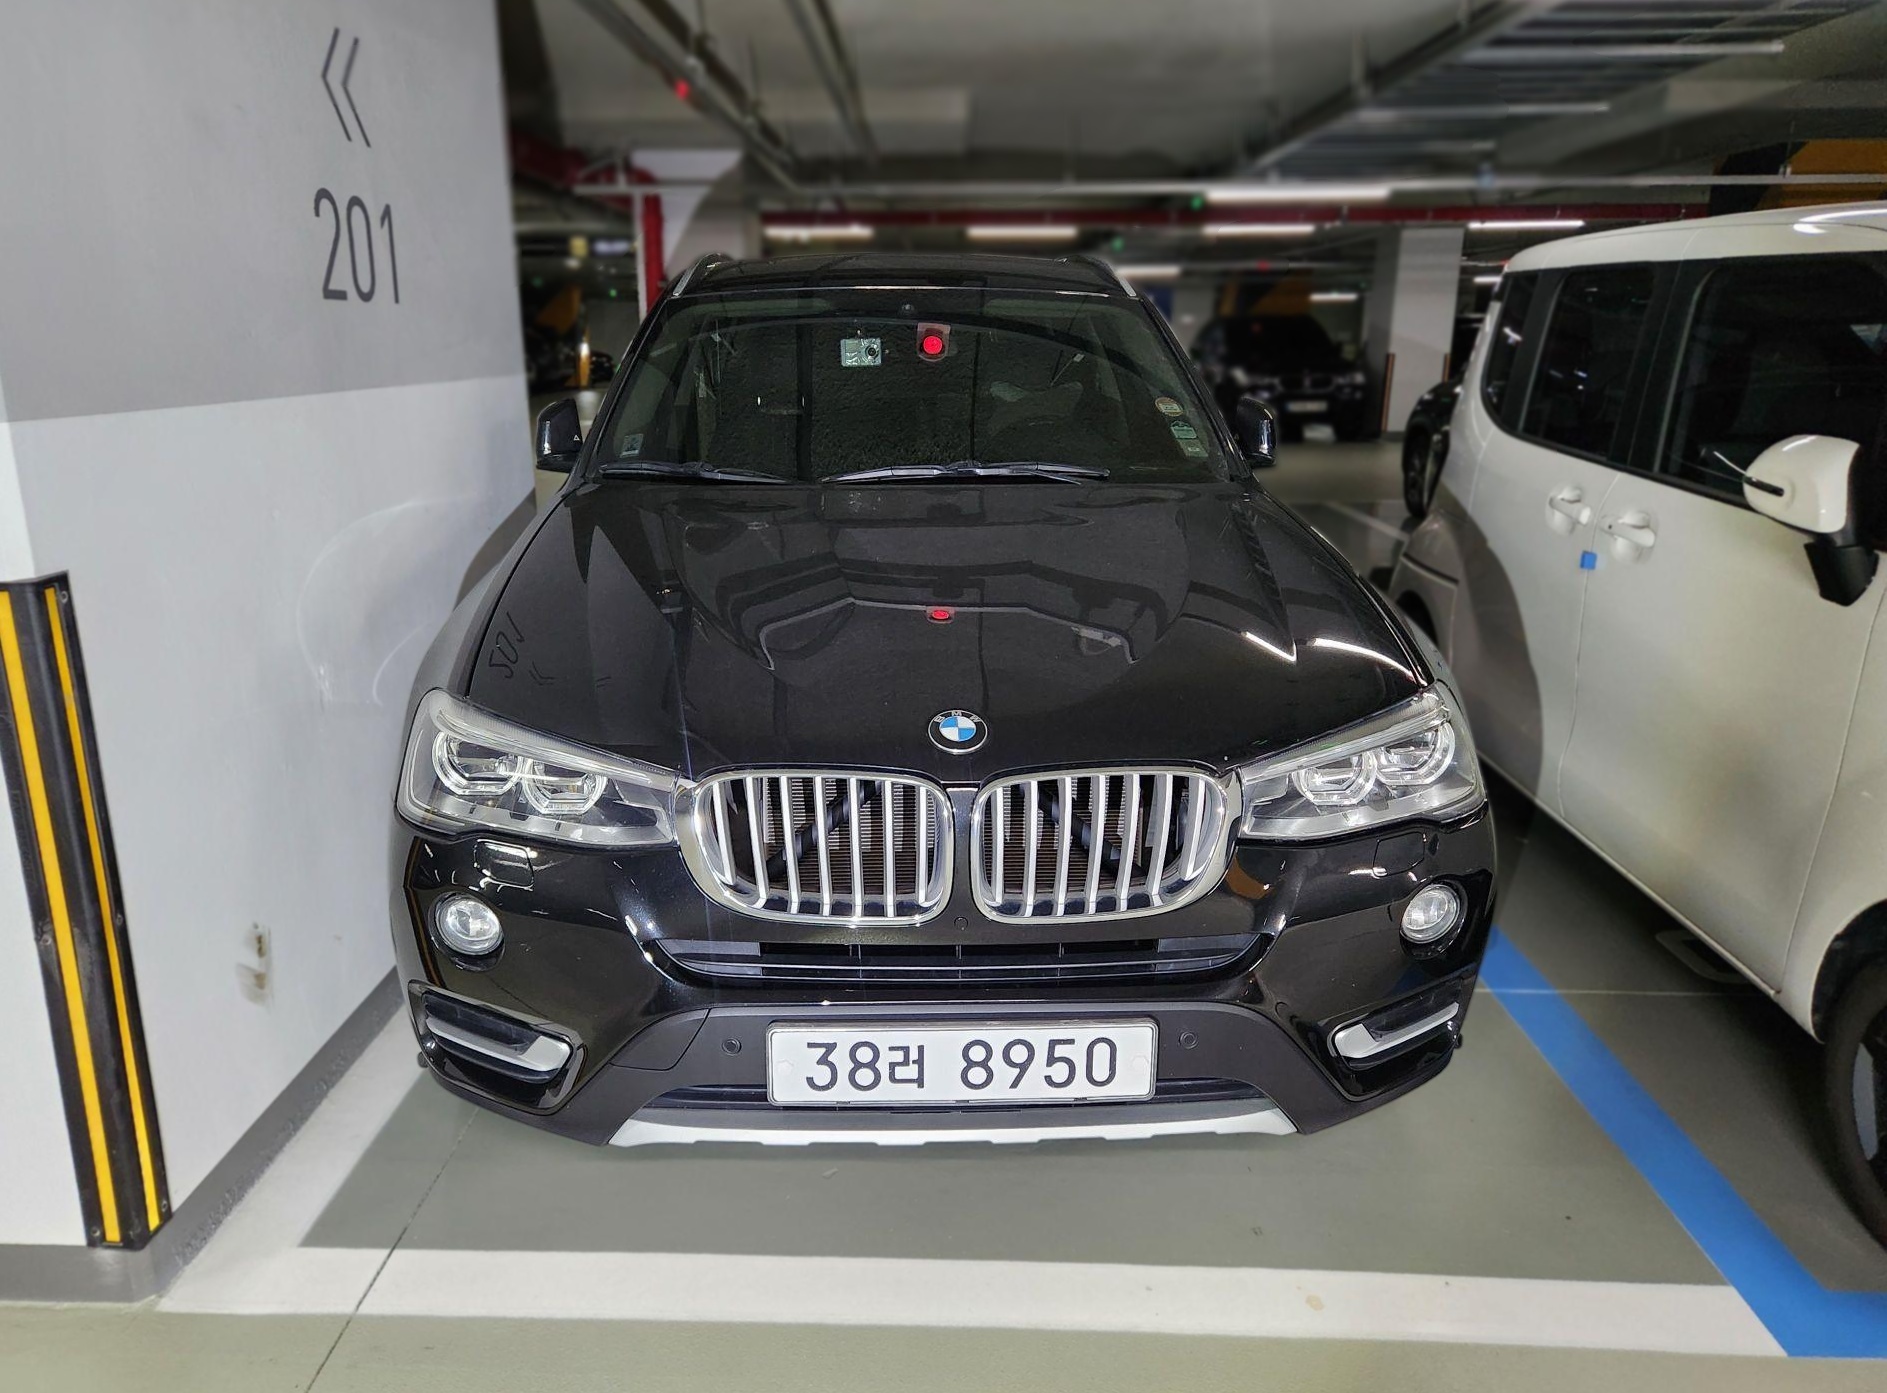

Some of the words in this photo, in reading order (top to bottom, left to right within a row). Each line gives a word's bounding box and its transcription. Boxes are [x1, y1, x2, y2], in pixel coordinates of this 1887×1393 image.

[313, 187, 399, 304] 201
[933, 711, 982, 723] BMW
[805, 1041, 925, 1091] 38러
[960, 1037, 1117, 1090] 8950
